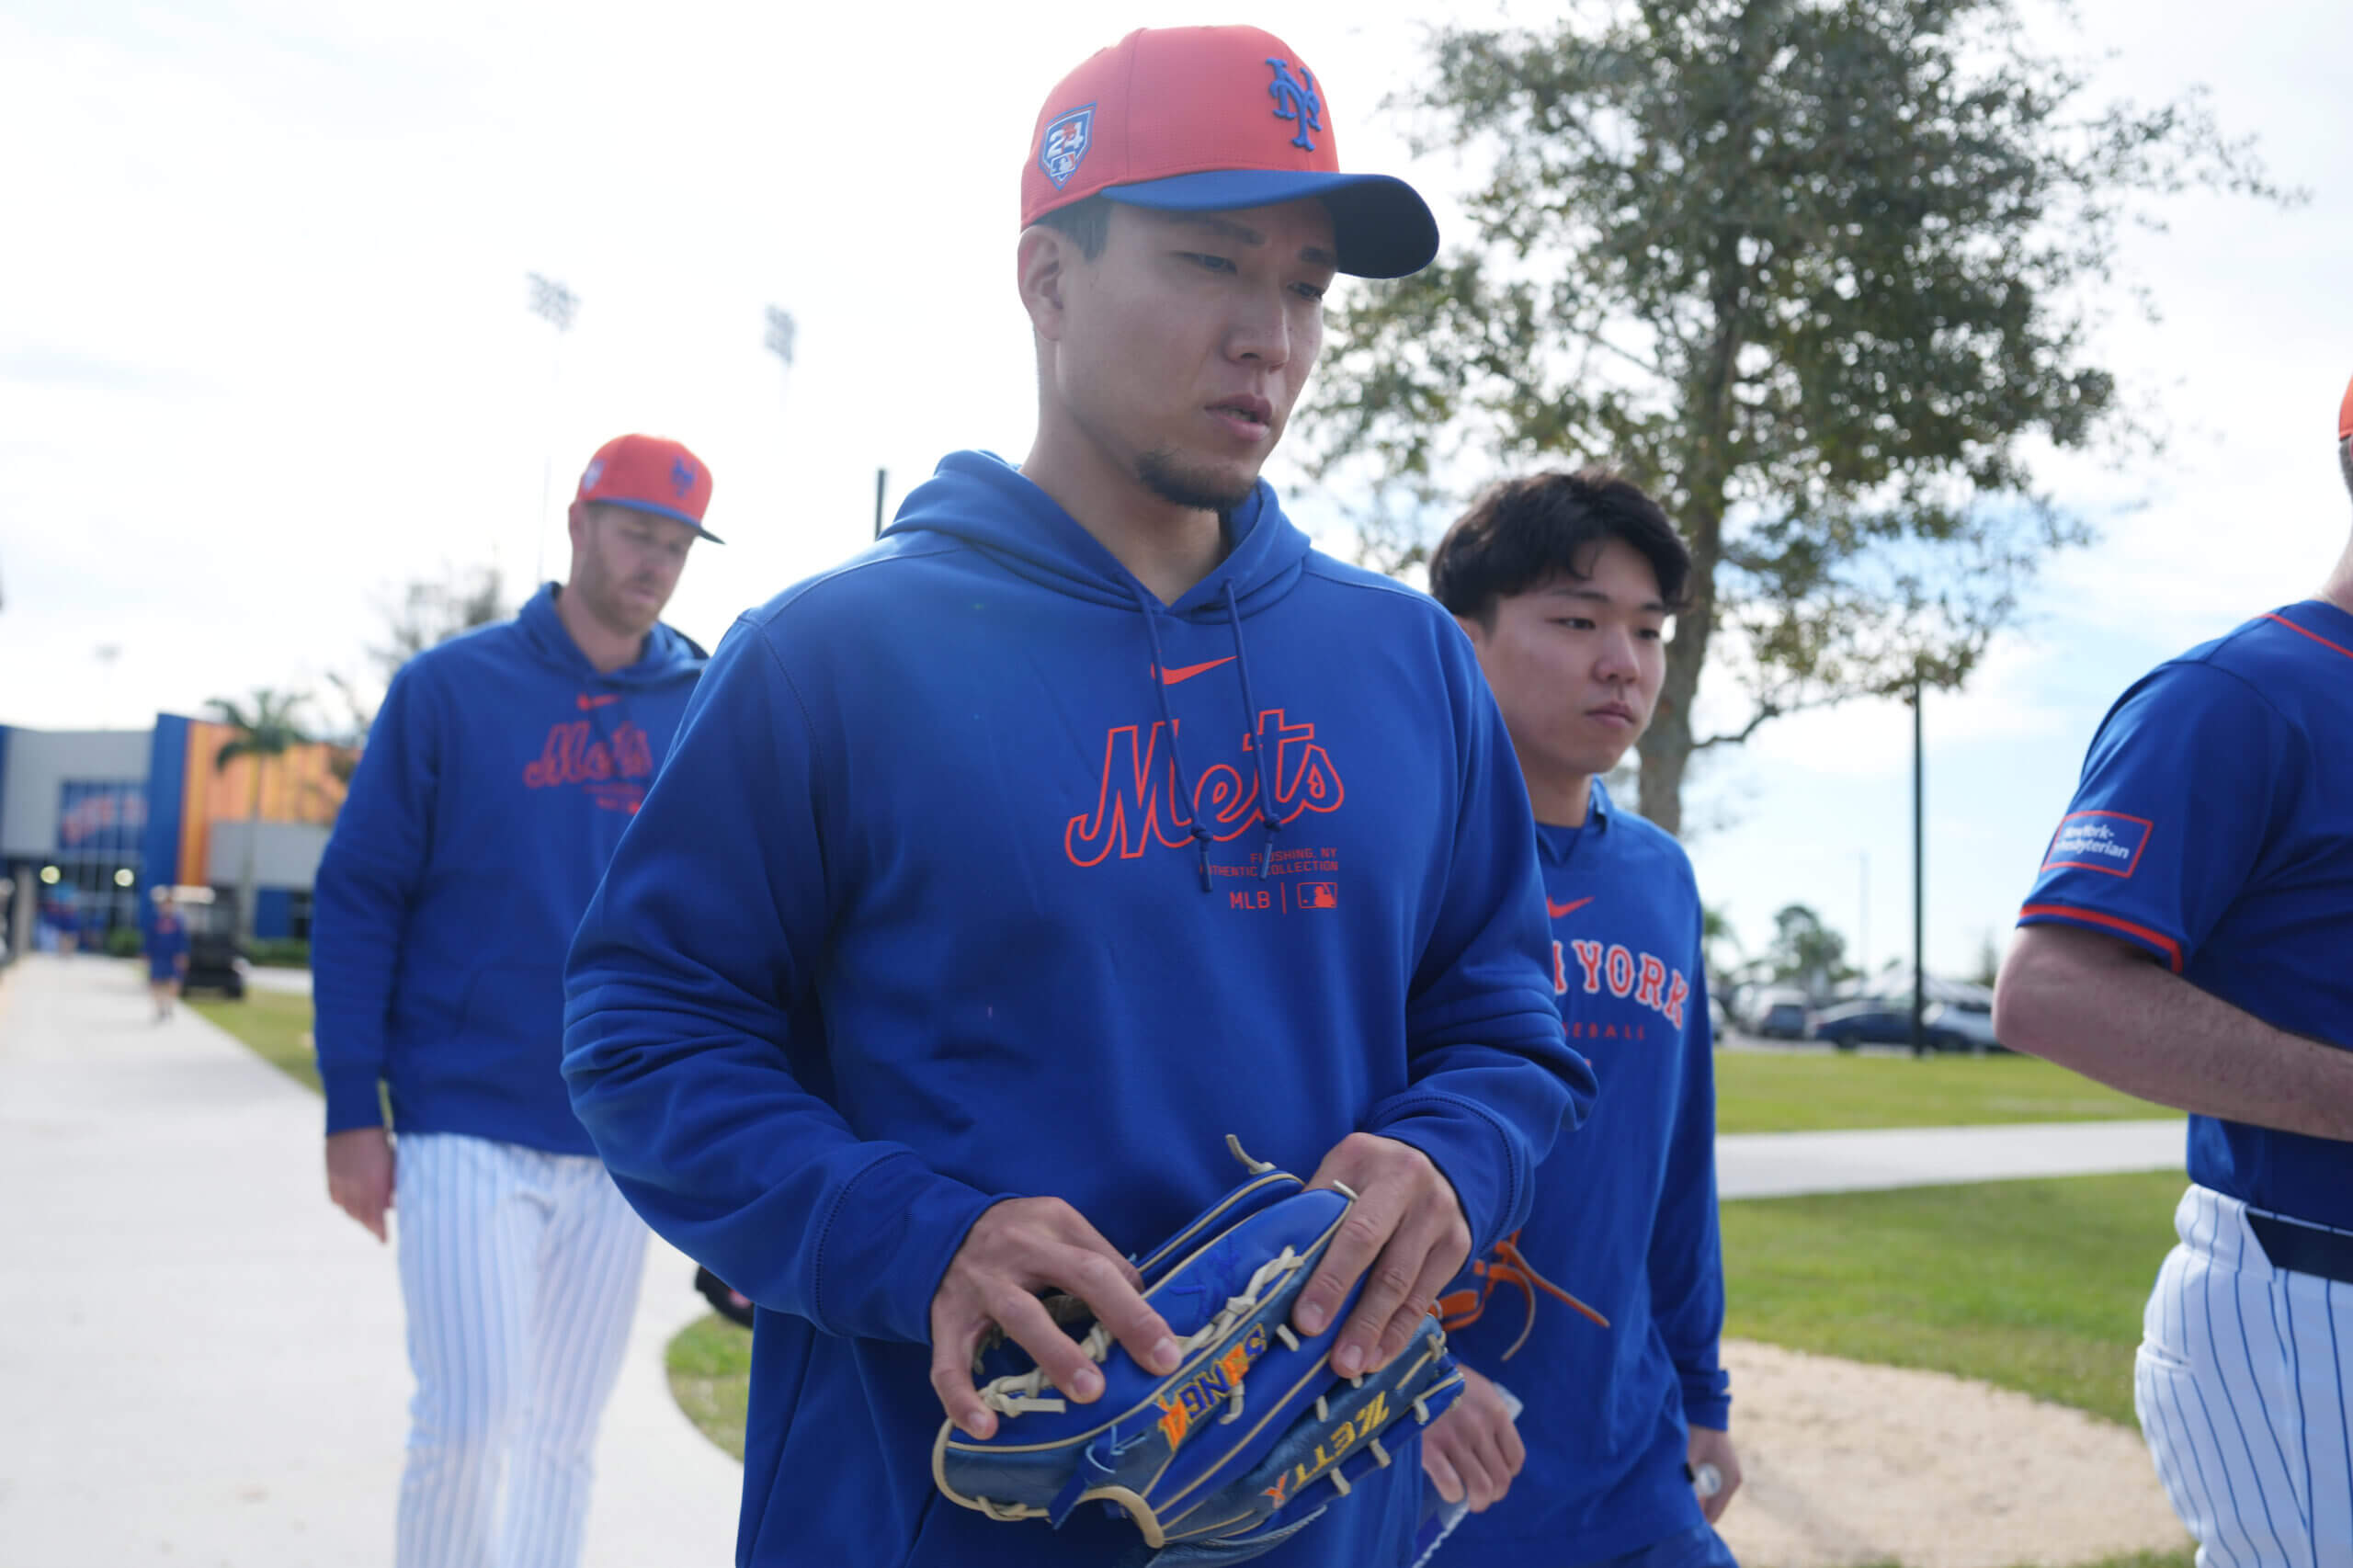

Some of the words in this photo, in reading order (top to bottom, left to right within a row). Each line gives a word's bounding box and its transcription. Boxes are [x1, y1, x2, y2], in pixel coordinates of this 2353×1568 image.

[1265, 58, 1322, 152] NY
[1048, 121, 1084, 157] 24
[1064, 708, 1345, 867] Mets
[2064, 824, 2115, 840] York-
[1321, 847, 1338, 858] NY
[2055, 838, 2130, 859] byterian
[1199, 864, 1258, 877] THENTIC
[1229, 890, 1271, 910] MLB
[1571, 939, 1689, 1031] YORK
[1563, 1022, 1646, 1040] EBALL
[1292, 1391, 1390, 1492] ZETT
